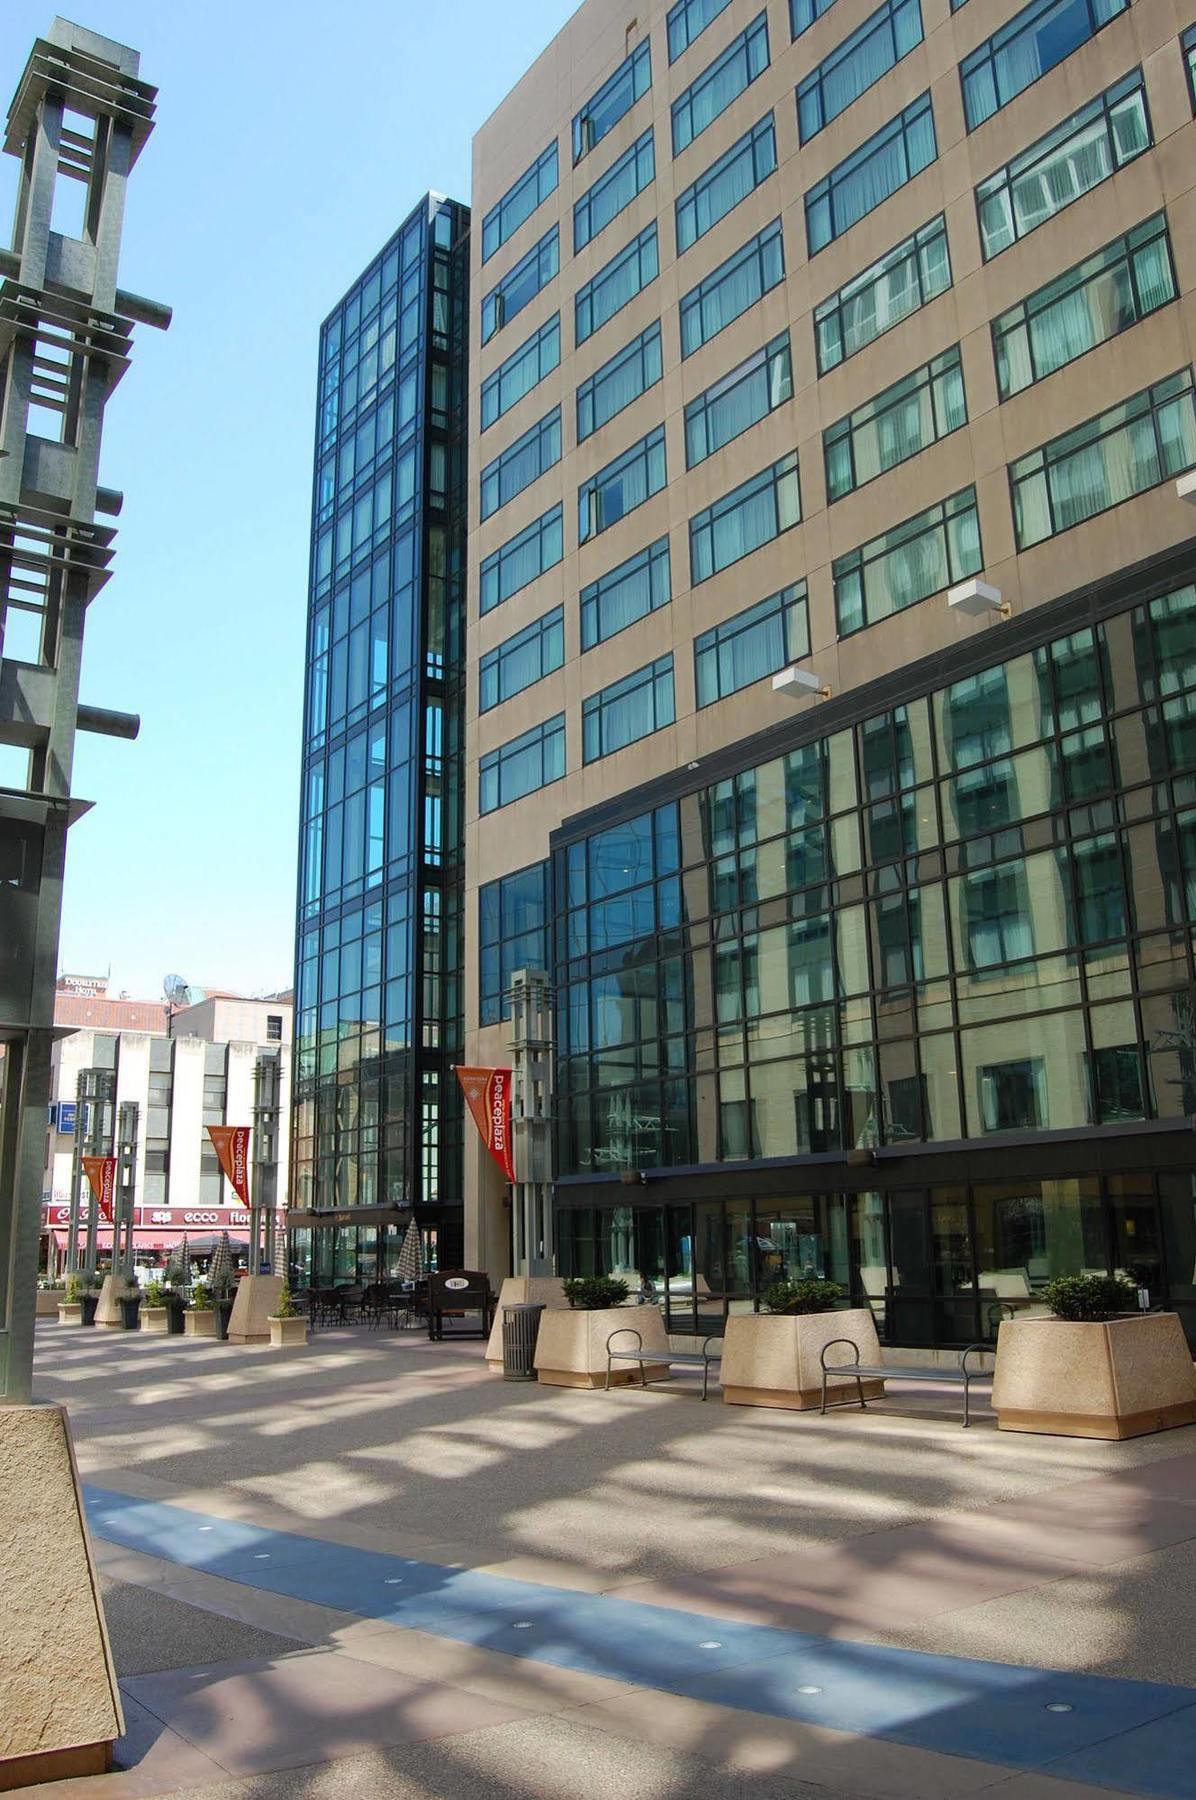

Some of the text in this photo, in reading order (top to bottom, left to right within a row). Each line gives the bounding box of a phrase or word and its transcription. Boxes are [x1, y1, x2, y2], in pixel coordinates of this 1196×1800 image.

[492, 1075, 505, 1151] peaceplaza
[235, 1131, 246, 1185] peaceplaza
[103, 1161, 113, 1204] peaceplaza
[184, 1212, 218, 1223] ecco
